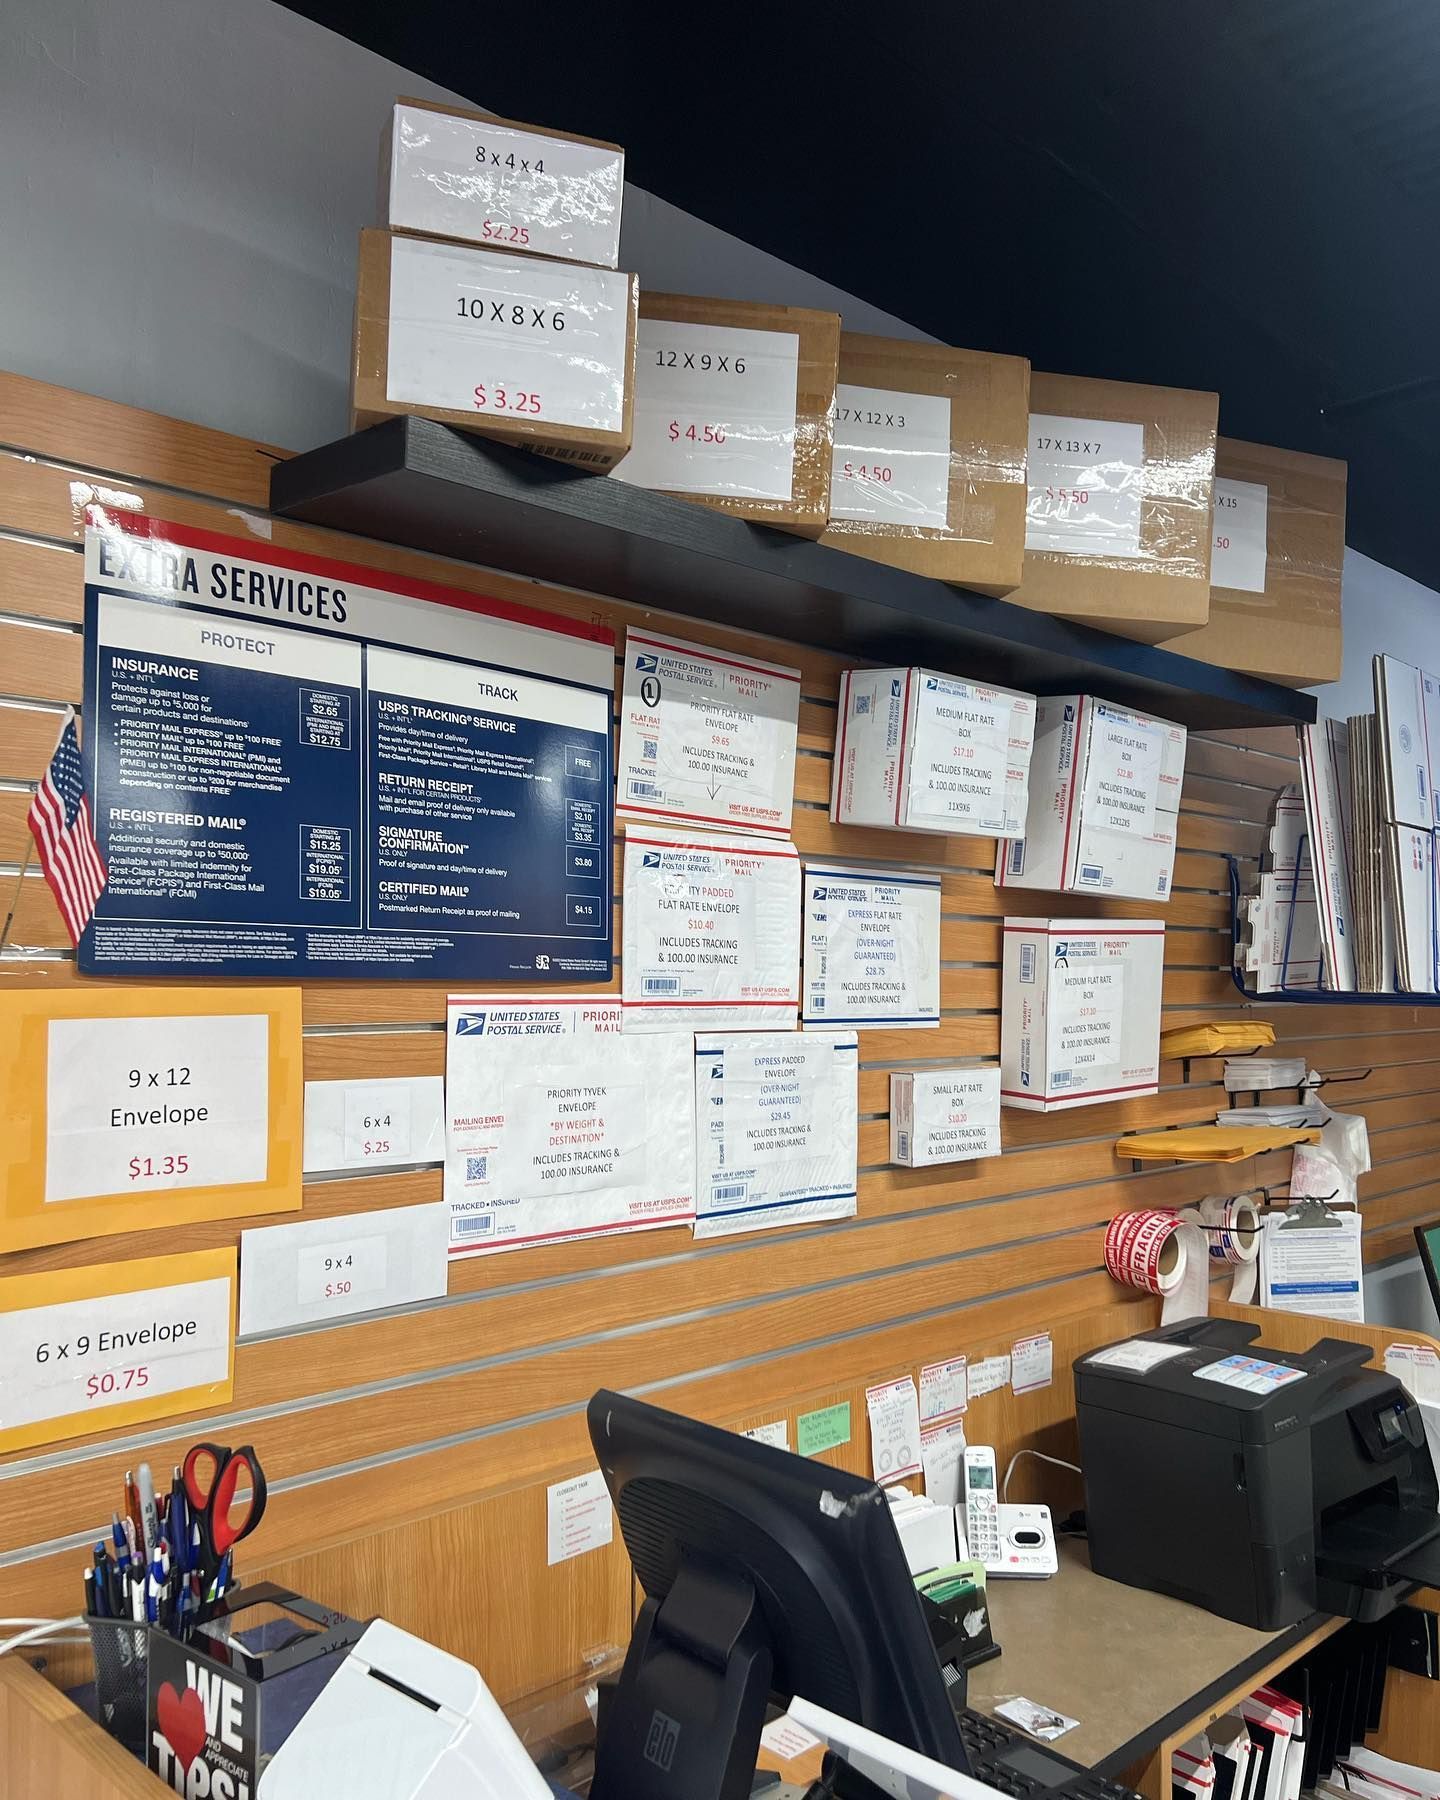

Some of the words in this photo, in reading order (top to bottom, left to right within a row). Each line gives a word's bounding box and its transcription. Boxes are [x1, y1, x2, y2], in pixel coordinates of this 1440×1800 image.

[476, 146, 486, 163] 8
[491, 153, 500, 167] x
[505, 152, 516, 169] 4
[521, 159, 530, 172] x
[534, 158, 545, 174] 4
[482, 220, 531, 245] $2.25
[457, 297, 484, 321] 10
[490, 302, 504, 323] X
[512, 305, 525, 326] 8
[532, 308, 545, 330] X
[552, 310, 565, 331] 6
[656, 350, 677, 369] 12
[683, 352, 695, 370] X
[700, 354, 711, 371] 9
[717, 356, 729, 373] X
[734, 357, 746, 374] 6
[473, 384, 486, 410] $
[494, 388, 542, 415] 3.25
[834, 409, 850, 423] 17
[854, 410, 862, 423] X
[866, 411, 881, 425] 12
[885, 413, 894, 426] X
[898, 414, 905, 428] 3
[668, 420, 679, 442] $
[685, 424, 726, 445] 4.50
[1037, 438, 1050, 451] 17
[1055, 440, 1062, 452] X
[1066, 440, 1079, 453] 13
[1083, 442, 1091, 454] X
[1095, 442, 1101, 454] 7
[844, 463, 853, 480] $
[858, 465, 892, 483] 4.50
[1046, 486, 1055, 501] $
[1059, 488, 1089, 504] 5.50
[1219, 496, 1225, 507] X
[1227, 498, 1237, 508] 15
[99, 541, 199, 594] EXTRA
[211, 563, 347, 623] SERVICES
[201, 630, 276, 656] PROTECT
[112, 656, 199, 681] INSURANCE
[730, 674, 768, 691] PRIORITY
[112, 682, 148, 695] Protects
[150, 686, 180, 700] against
[182, 691, 199, 702] loss
[200, 695, 209, 703] or
[478, 682, 518, 702] TRACK
[738, 688, 758, 698] MAIL
[312, 704, 338, 717] $2.65
[378, 700, 409, 715] USPS
[473, 716, 516, 734] SERVICE
[691, 702, 721, 717] PRIORITY
[722, 708, 737, 720] FLAT
[738, 712, 754, 724] RATE
[936, 707, 963, 721] MEDIUM
[964, 711, 978, 722] FLAT
[980, 714, 995, 726] RATE
[706, 718, 738, 733] ENVELOPE
[959, 728, 971, 738] BOX
[310, 734, 341, 746] $12.75
[1108, 734, 1123, 746] LARGE
[1124, 736, 1135, 748] FLAT
[1136, 740, 1148, 752] RATE
[575, 758, 592, 768] FREE
[1122, 752, 1132, 761] BOX
[378, 773, 426, 789] RETURN
[428, 778, 473, 795] RECEIPT
[110, 808, 204, 827] REGISTERED
[378, 825, 443, 842] SIGNATURE
[310, 840, 341, 851] $15.25
[378, 858, 397, 869] Proof
[398, 860, 405, 868] of
[406, 861, 436, 872] signature
[437, 864, 449, 872] and
[450, 864, 476, 875] day/time
[478, 866, 484, 875] of
[485, 868, 507, 877] delivery
[378, 881, 438, 896] CERTIFIED
[702, 888, 734, 898] PADDED
[576, 906, 593, 915] $4.15
[658, 900, 678, 910] FLAT
[680, 901, 700, 912] RATE
[702, 903, 740, 914] ENVELOPE
[848, 910, 872, 919] EXPRESS
[874, 911, 888, 920] FLAT
[888, 912, 902, 921] RATE
[688, 920, 714, 930] $10.40
[1064, 977, 1086, 986] MEDIUM
[1087, 976, 1099, 985] FLAT
[1099, 975, 1112, 984] RATE
[1083, 991, 1094, 999] BOX
[490, 1012, 527, 1022] UNITED
[528, 1012, 560, 1022] STATES
[487, 1024, 523, 1035] POSTAL
[594, 1023, 621, 1033] MAIL
[754, 1057, 781, 1066] EXPRESS
[782, 1056, 805, 1065] PADDED
[128, 1069, 140, 1088] 9
[148, 1072, 158, 1087] x
[167, 1067, 191, 1087] 12
[765, 1069, 796, 1078] ENVELOPE
[548, 1088, 582, 1100] PRIORITY
[583, 1086, 607, 1098] TYVEK
[933, 1084, 952, 1094] SMALL
[954, 1084, 965, 1093] FLAT
[967, 1083, 983, 1093] RATE
[558, 1102, 597, 1113] ENVELOPE
[952, 1098, 964, 1107] BOX
[110, 1104, 209, 1128] Envelope
[364, 1116, 371, 1128] 6
[374, 1118, 381, 1128] x
[383, 1114, 391, 1127] 4
[364, 1140, 390, 1155] $.25
[128, 1154, 189, 1181] $1.35
[451, 1202, 485, 1212] TRACKED
[1134, 1215, 1167, 1272] FRAGILE
[324, 1258, 332, 1271] 9
[335, 1260, 342, 1270] x
[344, 1255, 352, 1268] 4
[324, 1280, 351, 1298] $.50
[36, 1341, 49, 1363] 6
[58, 1344, 69, 1360] x
[77, 1336, 90, 1356] 9
[98, 1318, 197, 1353] Envelope
[86, 1367, 150, 1399] $0.75
[186, 1659, 244, 1753] WE
[206, 1737, 222, 1751] AND
[205, 1750, 249, 1780] APPRECIATE
